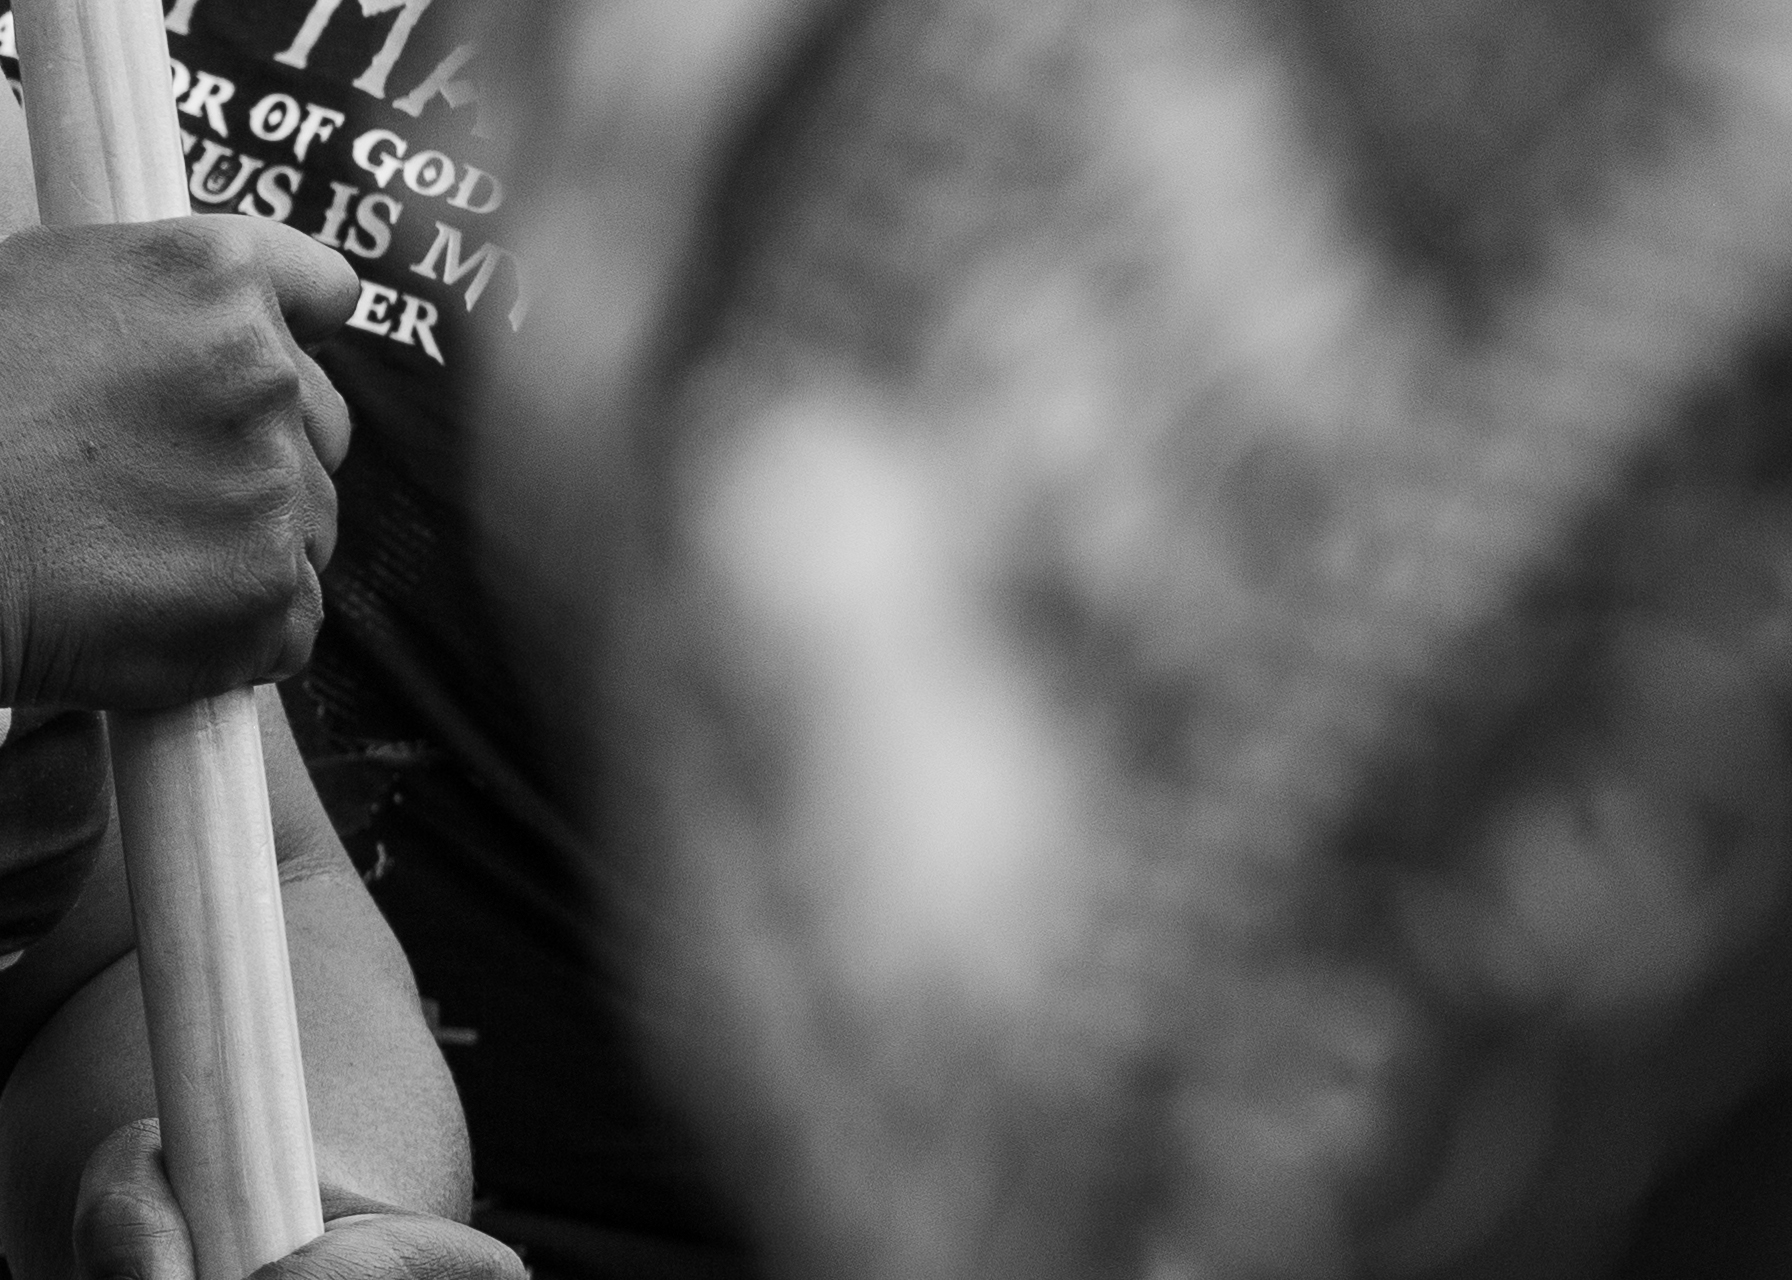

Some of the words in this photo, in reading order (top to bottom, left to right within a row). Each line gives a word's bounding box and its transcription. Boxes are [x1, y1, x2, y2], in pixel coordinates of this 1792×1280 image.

[180, 128, 304, 223] US
[312, 181, 404, 260] IS
[248, 93, 346, 164] OF
[352, 128, 504, 214] GOD
[345, 279, 445, 367] ER
